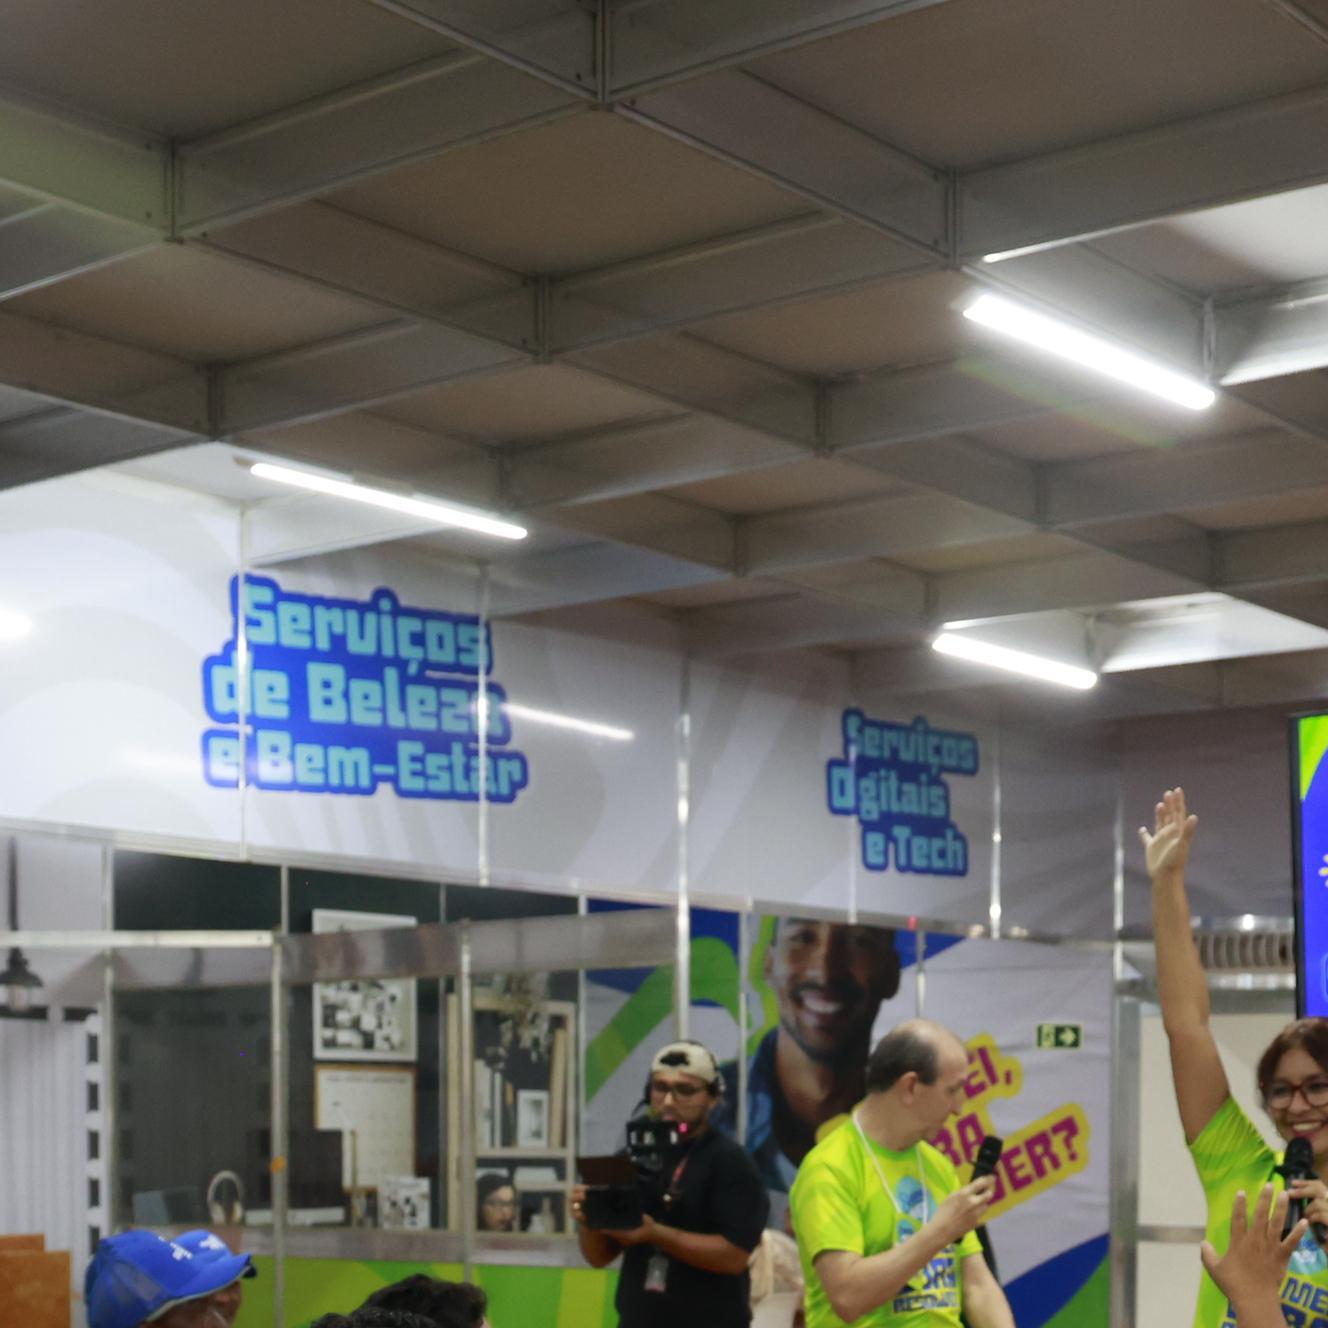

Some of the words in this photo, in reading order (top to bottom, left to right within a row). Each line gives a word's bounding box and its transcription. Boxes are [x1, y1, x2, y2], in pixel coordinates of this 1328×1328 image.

[239, 581, 491, 675] Serviços
[210, 648, 291, 720] de
[306, 661, 504, 738] Beleza
[208, 737, 240, 782] e
[256, 728, 524, 796] Bem-Estar
[846, 714, 976, 775] Serviços
[830, 765, 947, 821] Dgitais
[865, 831, 886, 866] e
[892, 825, 964, 871] Tech
